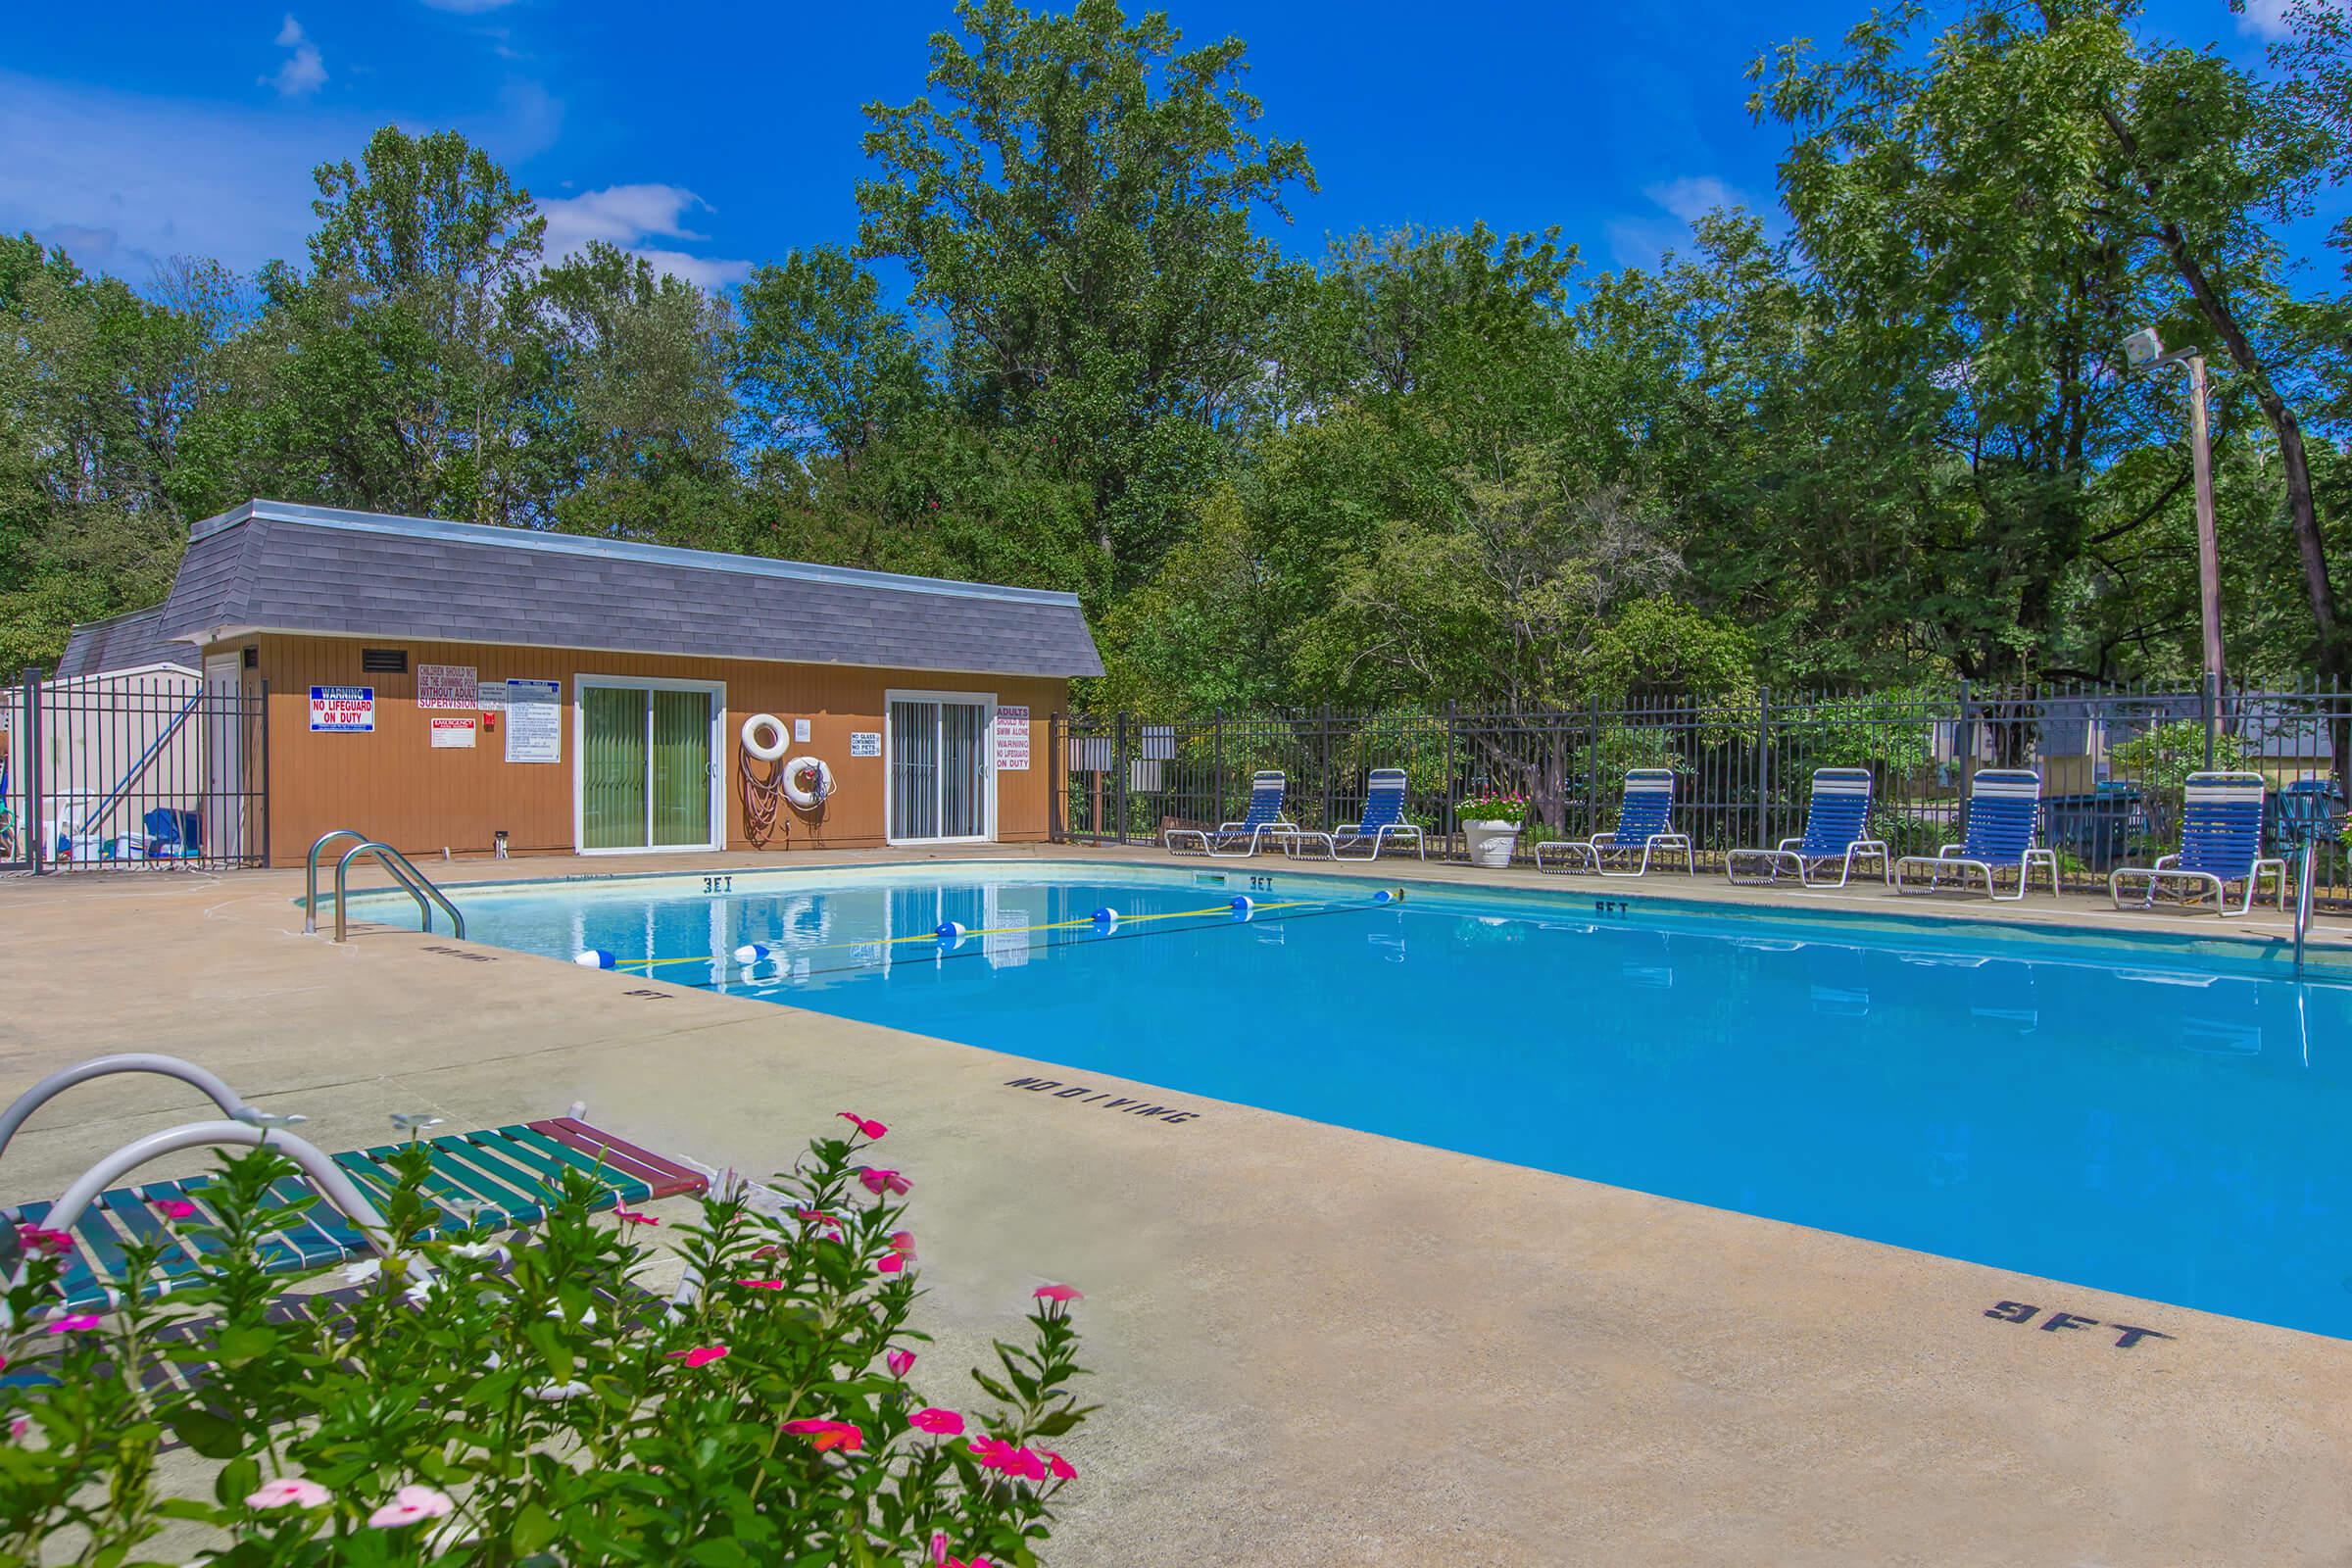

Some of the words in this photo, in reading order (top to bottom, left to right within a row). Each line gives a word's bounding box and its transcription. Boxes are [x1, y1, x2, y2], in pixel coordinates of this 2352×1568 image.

[419, 666, 444, 675] CHILDREN
[446, 666, 466, 676] SHOULD
[466, 667, 476, 677] NOT
[419, 675, 429, 686] USE
[430, 676, 439, 686] THE
[440, 676, 463, 687] SWIMMING
[321, 688, 364, 700] WARNING
[419, 687, 454, 697] WITHOUT
[455, 688, 476, 698] ADULT
[313, 700, 325, 711] NO
[328, 700, 371, 711] LIFEGUARD
[419, 697, 476, 708] SUPERVISION
[323, 711, 336, 723] ON
[340, 712, 362, 723] DUTY
[997, 708, 1028, 716] ADULTS
[1018, 717, 1028, 726] NOT
[1012, 727, 1028, 736] ALONE
[1004, 1077, 1062, 1092] NO
[1053, 1087, 1200, 1123] DIVING
[1984, 1300, 2178, 1348] 9FT
